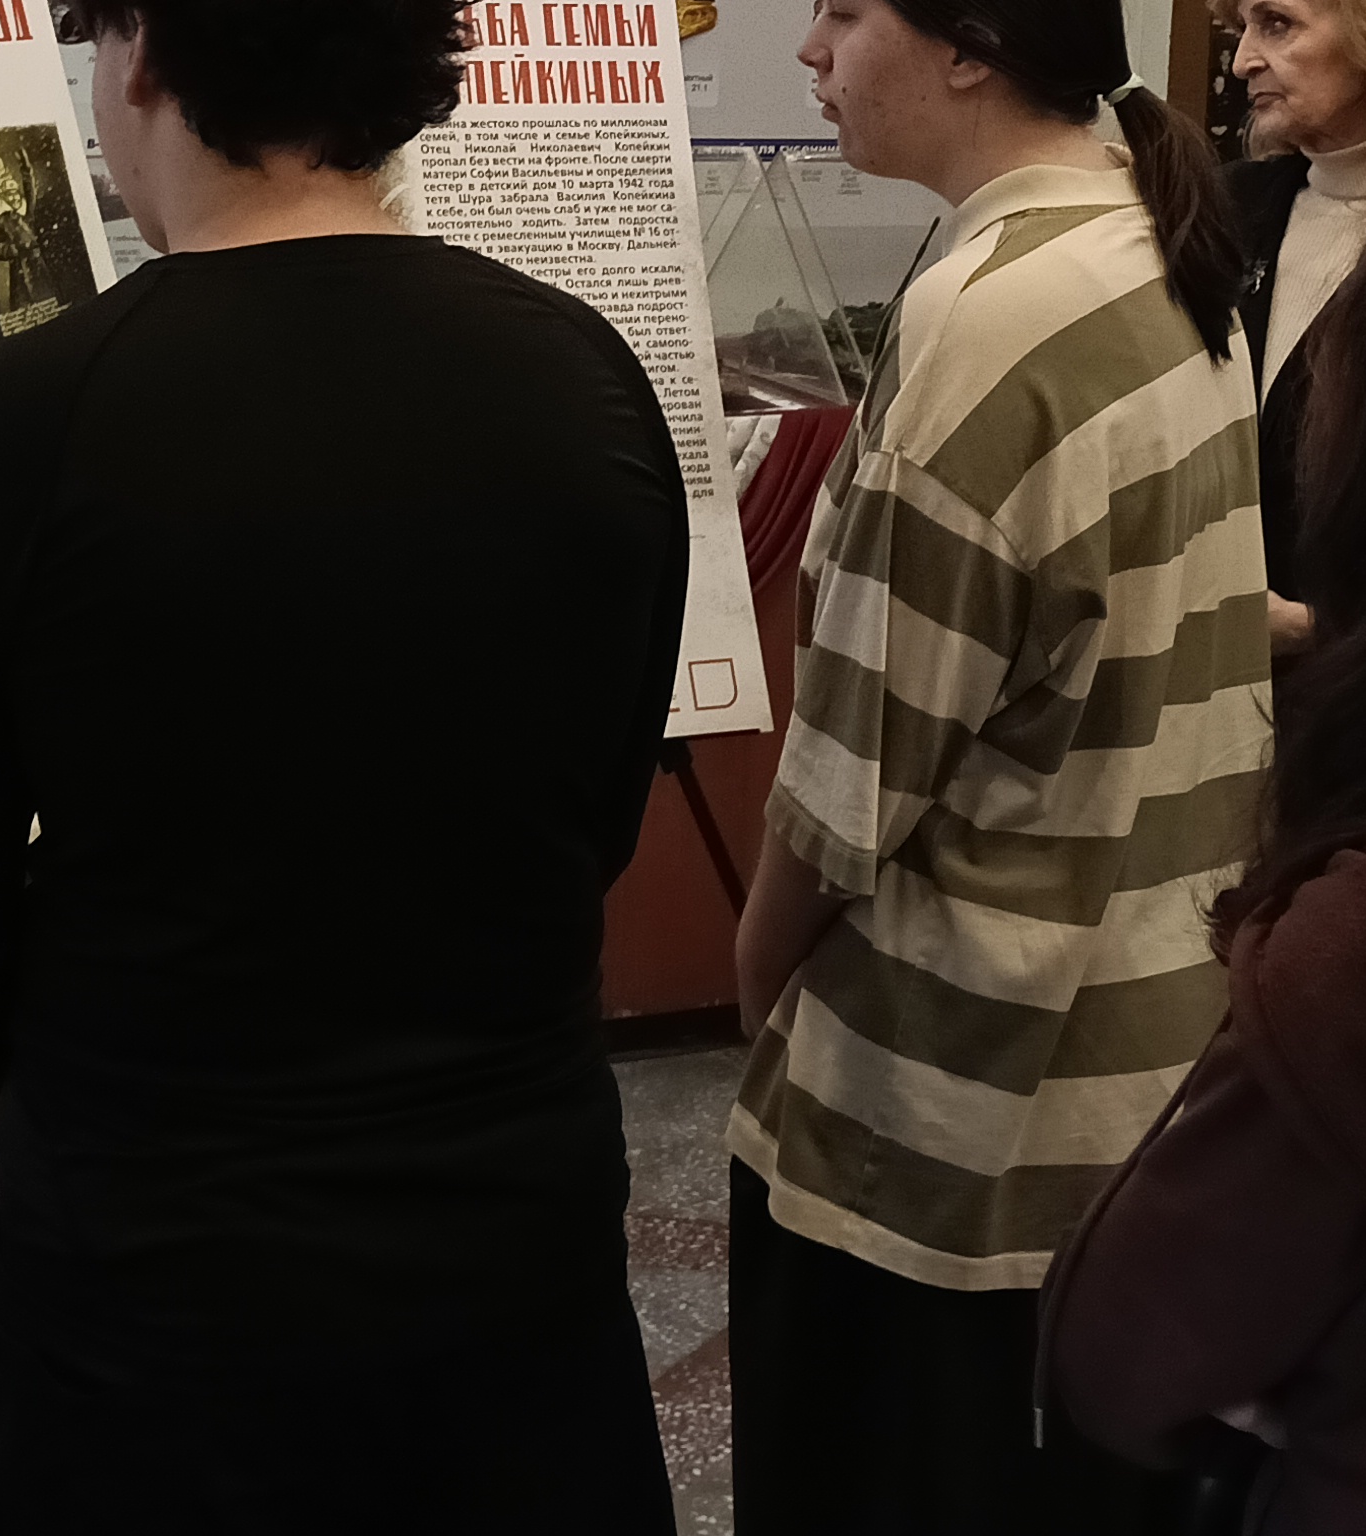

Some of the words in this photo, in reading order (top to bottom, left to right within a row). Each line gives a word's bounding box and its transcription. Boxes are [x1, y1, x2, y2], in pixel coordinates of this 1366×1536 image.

[460, 2, 529, 46] ЬБА
[542, 3, 657, 47] СЕМЬИ
[458, 54, 665, 104] ПЕЙКИНЫХ
[469, 120, 519, 128] жестоко
[521, 119, 580, 129] прошлась
[583, 119, 597, 127] по
[600, 119, 667, 130] миллионам
[464, 133, 471, 141] в
[476, 132, 498, 140] том
[503, 132, 538, 140] числе
[543, 132, 550, 140] и
[555, 132, 590, 140] семье
[420, 143, 450, 154] Отец
[464, 142, 516, 153] Николай
[530, 142, 600, 152] Николаевич
[614, 140, 670, 151] Копейкин
[421, 157, 466, 168] пропал
[469, 155, 489, 166] без
[492, 157, 525, 165] вести
[593, 153, 628, 164] После
[630, 155, 671, 165] смерти
[422, 170, 467, 181] матери
[469, 167, 509, 180] Софии
[511, 167, 583, 177] Васильевны
[586, 168, 593, 176] и
[595, 167, 672, 178] определения
